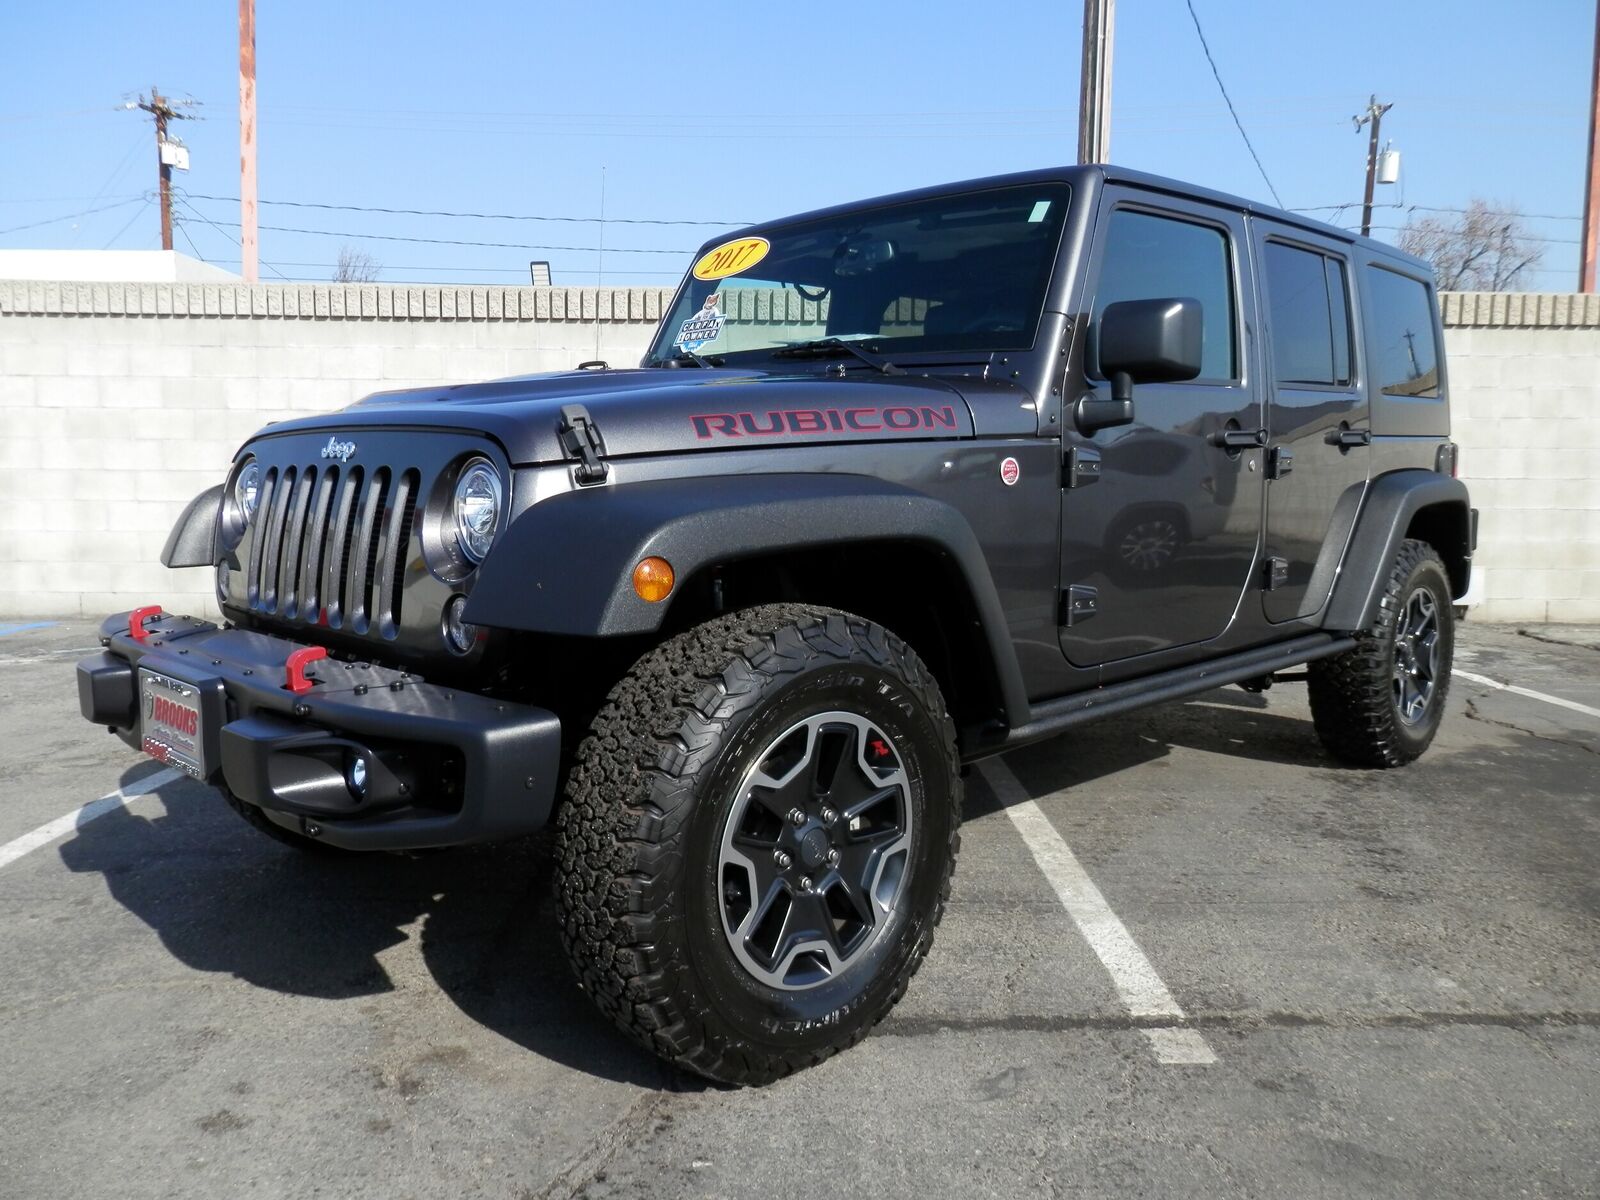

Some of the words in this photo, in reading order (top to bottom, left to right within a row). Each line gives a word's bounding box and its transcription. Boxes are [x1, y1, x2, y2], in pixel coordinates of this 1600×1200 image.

[701, 242, 761, 275] 2017
[683, 319, 721, 332] CARFAX
[685, 330, 717, 341] OWNER
[689, 405, 959, 441] RUBICON
[321, 436, 356, 463] Jeep
[154, 694, 198, 737] BROOKS
